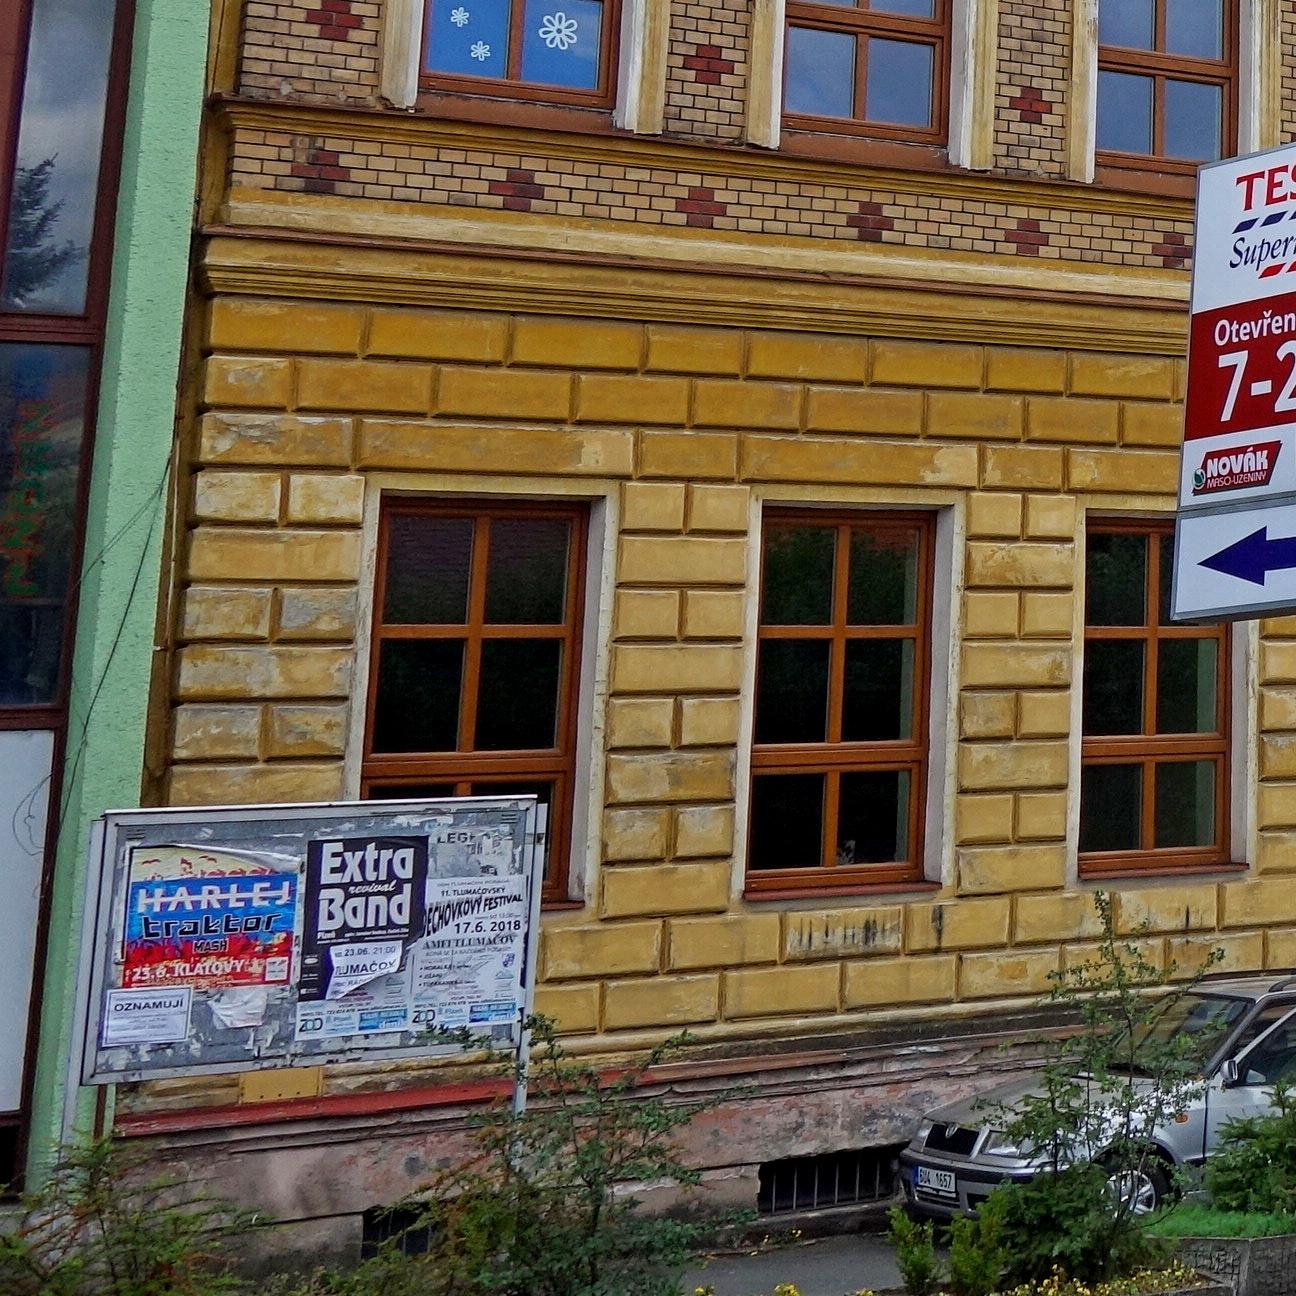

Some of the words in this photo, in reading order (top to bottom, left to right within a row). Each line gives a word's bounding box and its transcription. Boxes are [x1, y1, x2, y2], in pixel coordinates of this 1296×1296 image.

[1207, 446, 1269, 478] NOVÁK
[1206, 470, 1267, 489] MASO-UZENINY
[320, 842, 415, 885] Extra
[137, 880, 292, 915] HARLEJ
[347, 879, 399, 895] revival
[317, 883, 411, 932] Band
[483, 893, 523, 912] FESTIVAL
[141, 912, 283, 941] traktor
[455, 921, 487, 935] 17.6.
[490, 919, 522, 933] 2018
[192, 938, 229, 954] MASH
[131, 965, 170, 983] 23.6.
[172, 958, 245, 979] KLATOVY
[114, 997, 185, 1012] OZNAMUJÍ
